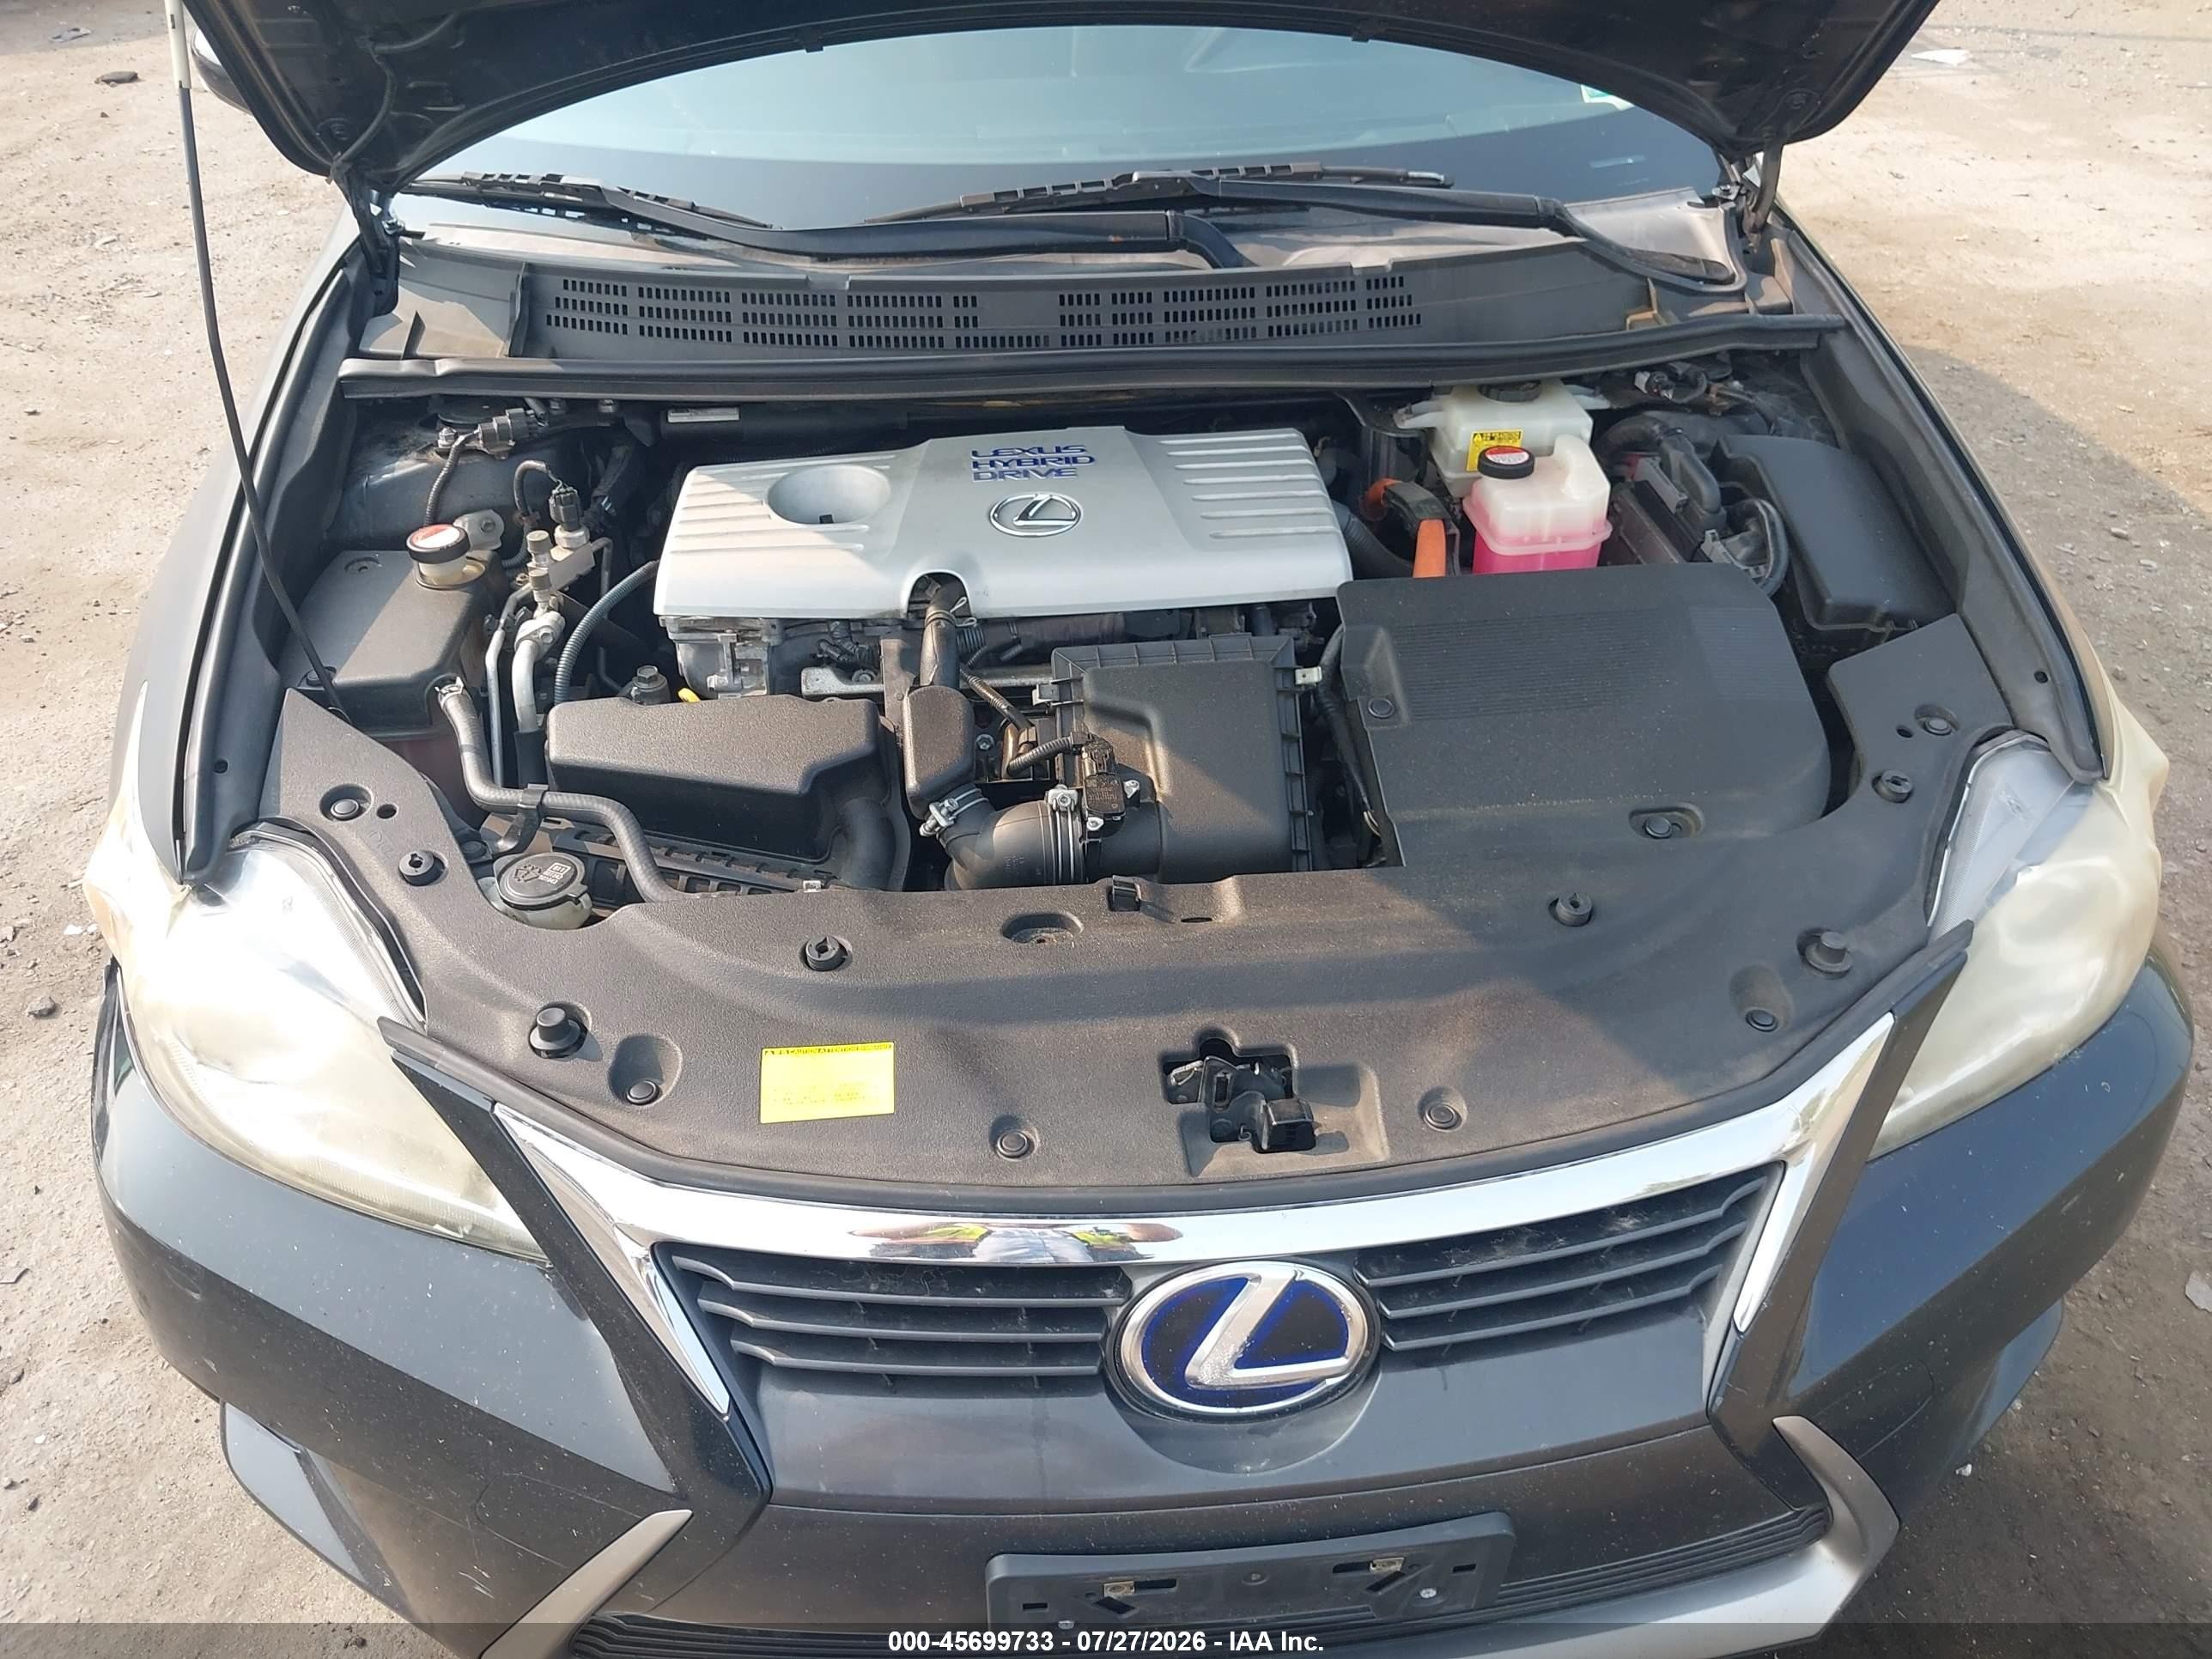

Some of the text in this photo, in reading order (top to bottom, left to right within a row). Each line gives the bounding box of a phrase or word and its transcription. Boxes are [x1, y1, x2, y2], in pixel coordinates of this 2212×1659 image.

[971, 445, 1087, 459] LEXUS
[972, 455, 1096, 471] HYBRID
[973, 467, 1079, 482] DRIVE
